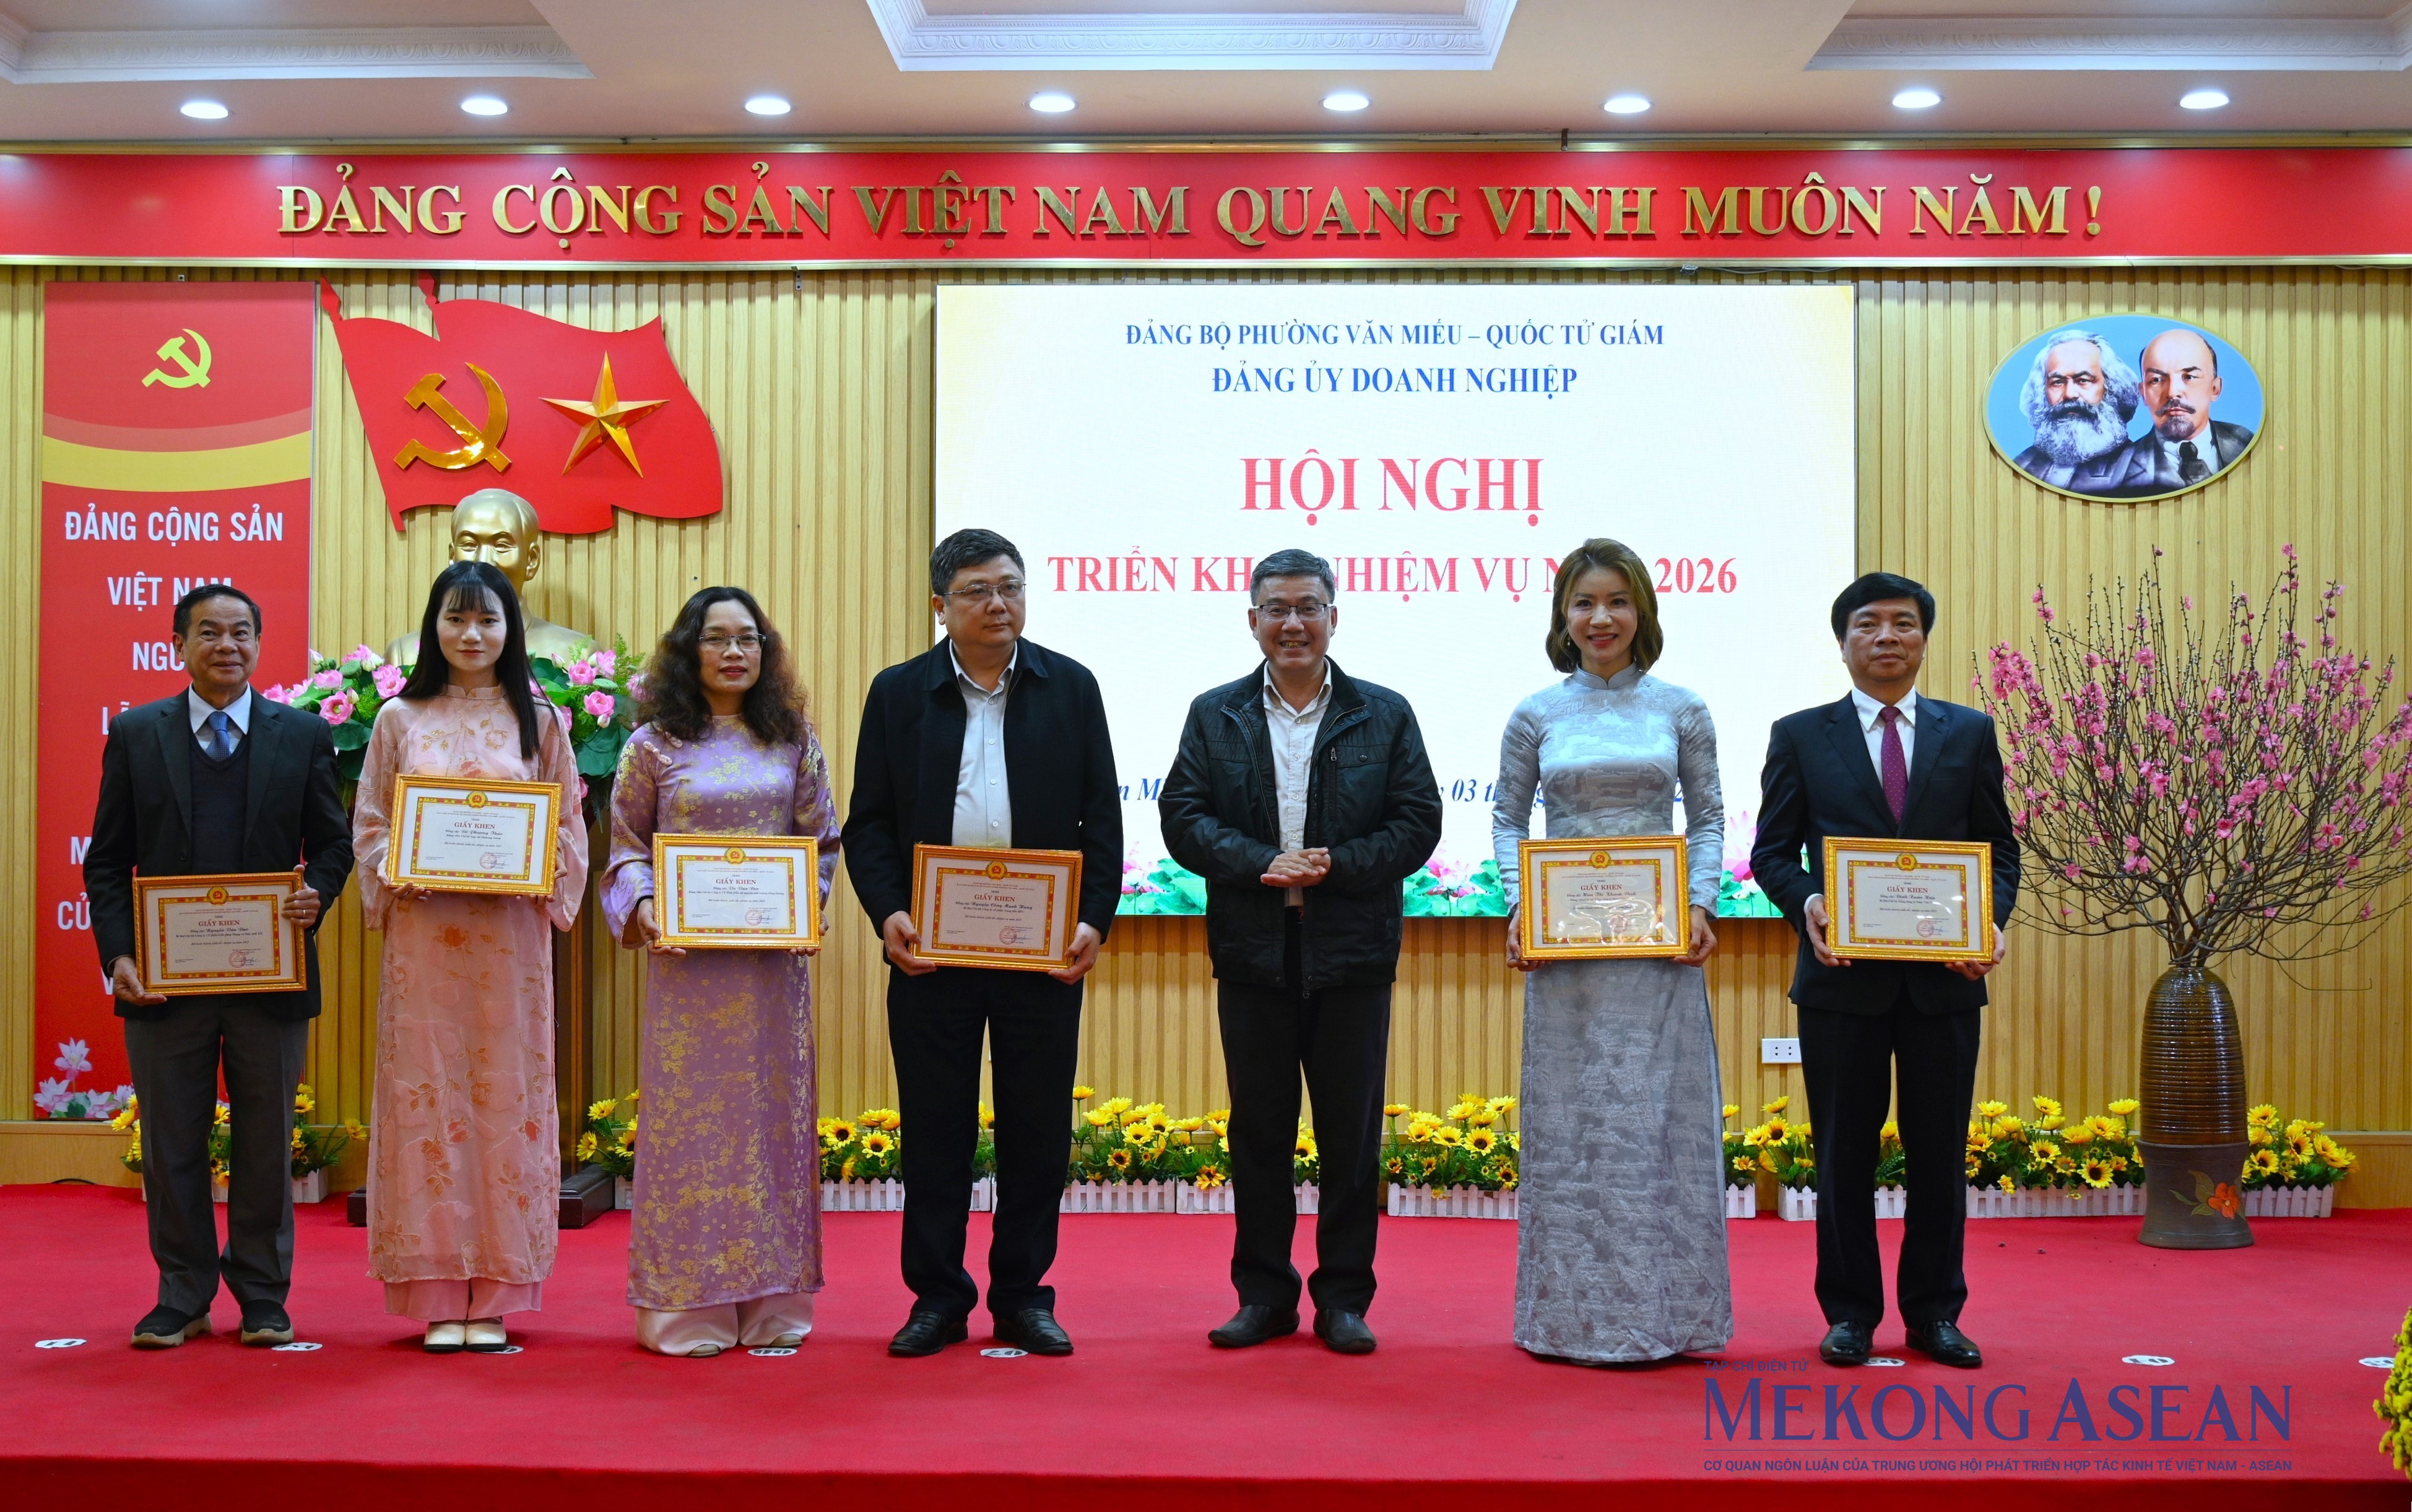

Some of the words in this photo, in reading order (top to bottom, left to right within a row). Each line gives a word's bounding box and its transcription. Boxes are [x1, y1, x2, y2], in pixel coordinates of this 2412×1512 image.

[277, 162, 466, 236] ĐẢNG
[492, 166, 683, 249] CỘNG
[702, 160, 833, 235] SẢN
[850, 169, 1016, 249] VIỆT
[1033, 185, 1190, 235] NAM
[1217, 185, 1460, 246] QUANG
[1480, 186, 1657, 236] VINH
[1680, 172, 1887, 236] MUÔN
[1909, 173, 2070, 235] NĂM
[1126, 318, 1192, 345] ĐẢNG
[1199, 321, 1231, 350] BỘ
[1238, 319, 1339, 345] PHƯỜNG
[1346, 319, 1394, 345] VĂN
[1401, 319, 1462, 345] MIẾU
[1486, 319, 1554, 349] QUỐC
[1561, 319, 1595, 345] TỬ
[1600, 319, 1664, 345] GIÁM
[1212, 360, 1295, 392] ĐẢNG
[1304, 360, 1343, 392] ỦY
[1351, 368, 1457, 392] DOANH
[1464, 365, 1577, 400] NGHIỆP
[1239, 449, 1360, 526] HỘI
[1378, 457, 1544, 527] NGHỊ
[65, 503, 137, 542] ĐẢNG
[147, 506, 220, 546] CỘNG
[230, 503, 283, 542] SẢN
[107, 571, 163, 611] VIỆT
[1048, 545, 1179, 592] TRIỂN
[1191, 557, 1256, 592] KH
[1471, 557, 1530, 603] VỤ
[1655, 557, 1737, 593] 2026
[1452, 779, 1477, 802] 03
[58, 892, 92, 930] CỦ
[198, 918, 217, 927] GIẤY
